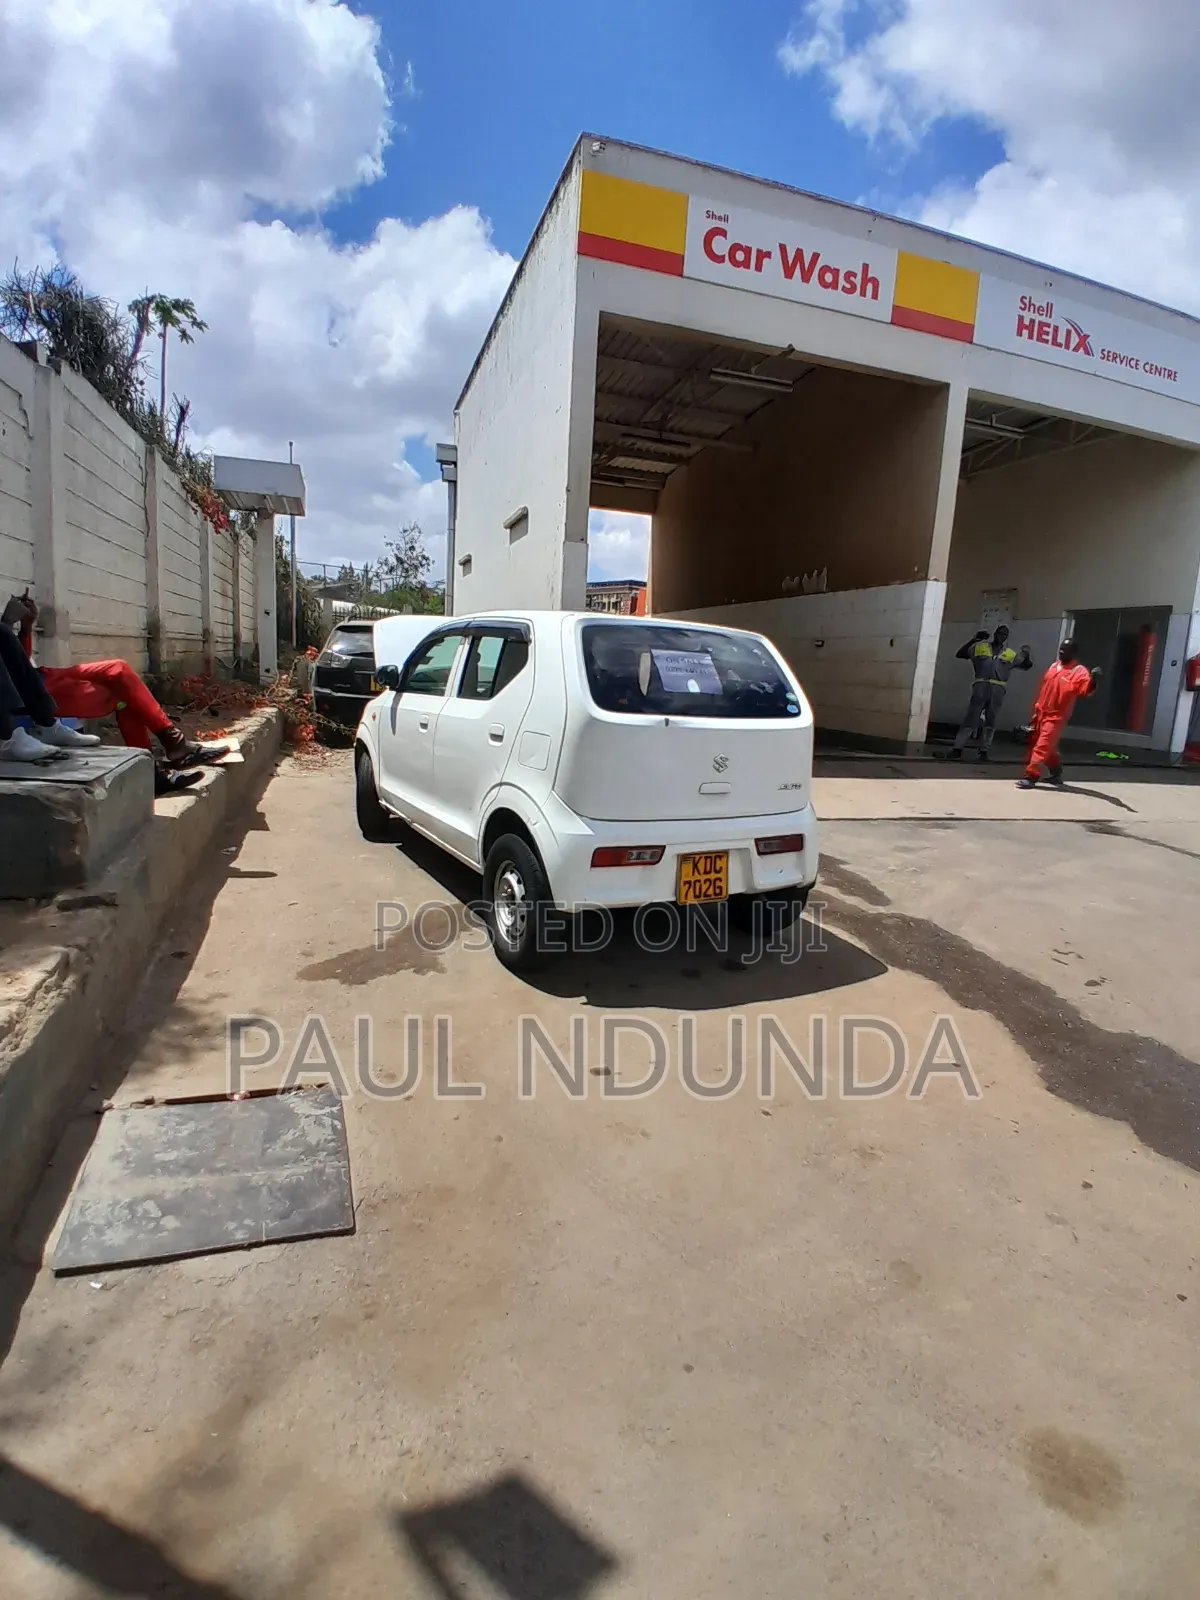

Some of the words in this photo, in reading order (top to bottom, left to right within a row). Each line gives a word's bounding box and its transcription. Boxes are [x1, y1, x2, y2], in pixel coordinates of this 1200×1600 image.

[705, 209, 730, 224] Shell
[703, 226, 772, 273] Car
[778, 242, 880, 301] Wash
[1018, 295, 1054, 319] Shell
[1016, 314, 1095, 357] HELIX
[1099, 348, 1140, 371] SERVICE
[1142, 361, 1179, 382] CENTRE
[691, 855, 723, 877] KDC
[682, 876, 723, 900] 702G
